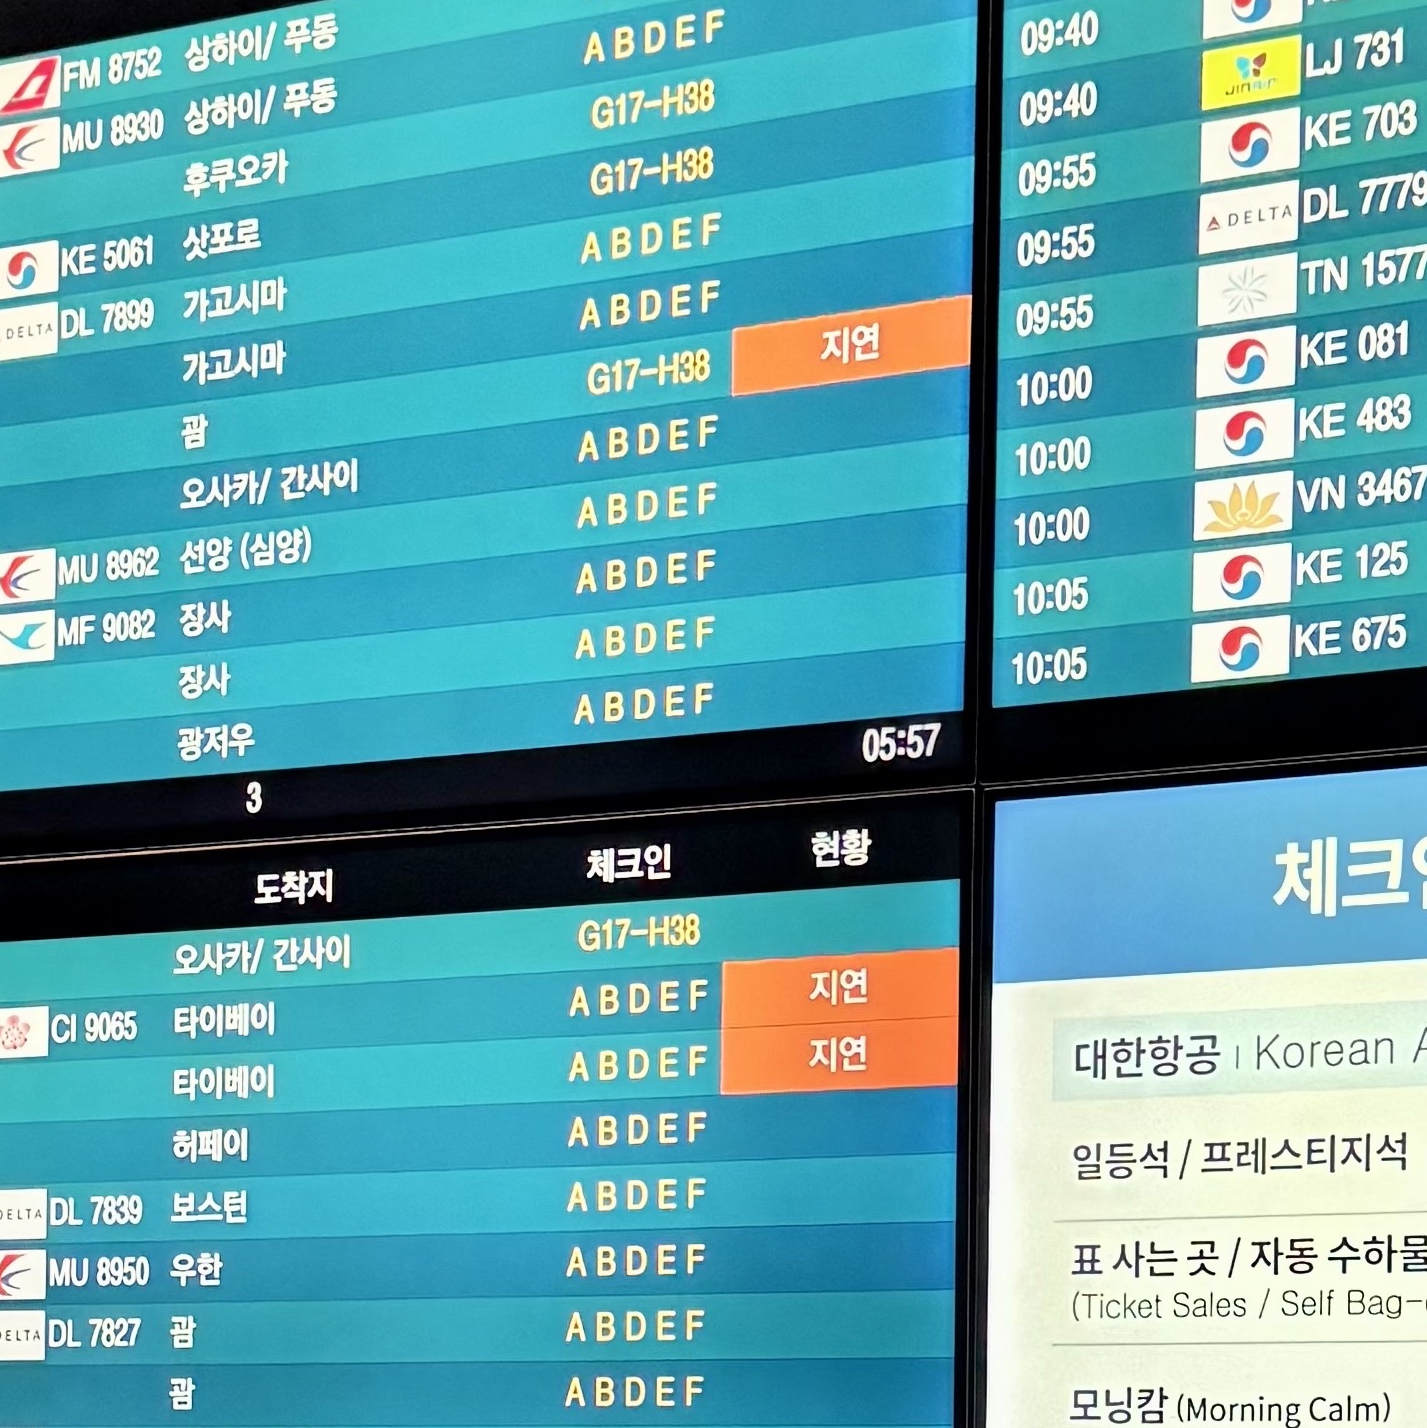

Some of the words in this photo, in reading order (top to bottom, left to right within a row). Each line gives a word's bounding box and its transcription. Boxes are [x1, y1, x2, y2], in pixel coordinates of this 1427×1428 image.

[591, 78, 715, 129] G17-H38
[1020, 81, 1097, 126] 09:40
[1228, 205, 1292, 226] DELTA
[1303, 185, 1349, 223] DL
[821, 323, 879, 364] 지연
[1012, 646, 1087, 684] 10:05
[862, 723, 941, 762] 05:57
[246, 781, 262, 813] 3
[587, 843, 671, 883] 체크인
[811, 829, 872, 867] 현황
[810, 968, 867, 1005] 지연
[51, 1014, 76, 1043] CI
[85, 1011, 137, 1042] 9065
[174, 1001, 274, 1039] 타이베이
[1076, 1035, 1221, 1080] 대한항공
[1257, 1034, 1393, 1070] Korean
[1074, 1140, 1168, 1180] 일등석
[1201, 1132, 1406, 1175] 프레스티지석
[171, 1190, 247, 1223] 보스턴
[1071, 1245, 1103, 1275] 표
[1112, 1241, 1178, 1278] 사는
[1187, 1241, 1219, 1276] 곳
[1251, 1237, 1318, 1275] 자동
[1073, 1291, 1162, 1321] (Ticket
[1173, 1292, 1246, 1318] Sales
[1282, 1289, 1334, 1316] Self
[1070, 1387, 1169, 1424] 모닝캄
[1177, 1394, 1301, 1428] (Morning
[1309, 1392, 1390, 1422] Calm)
